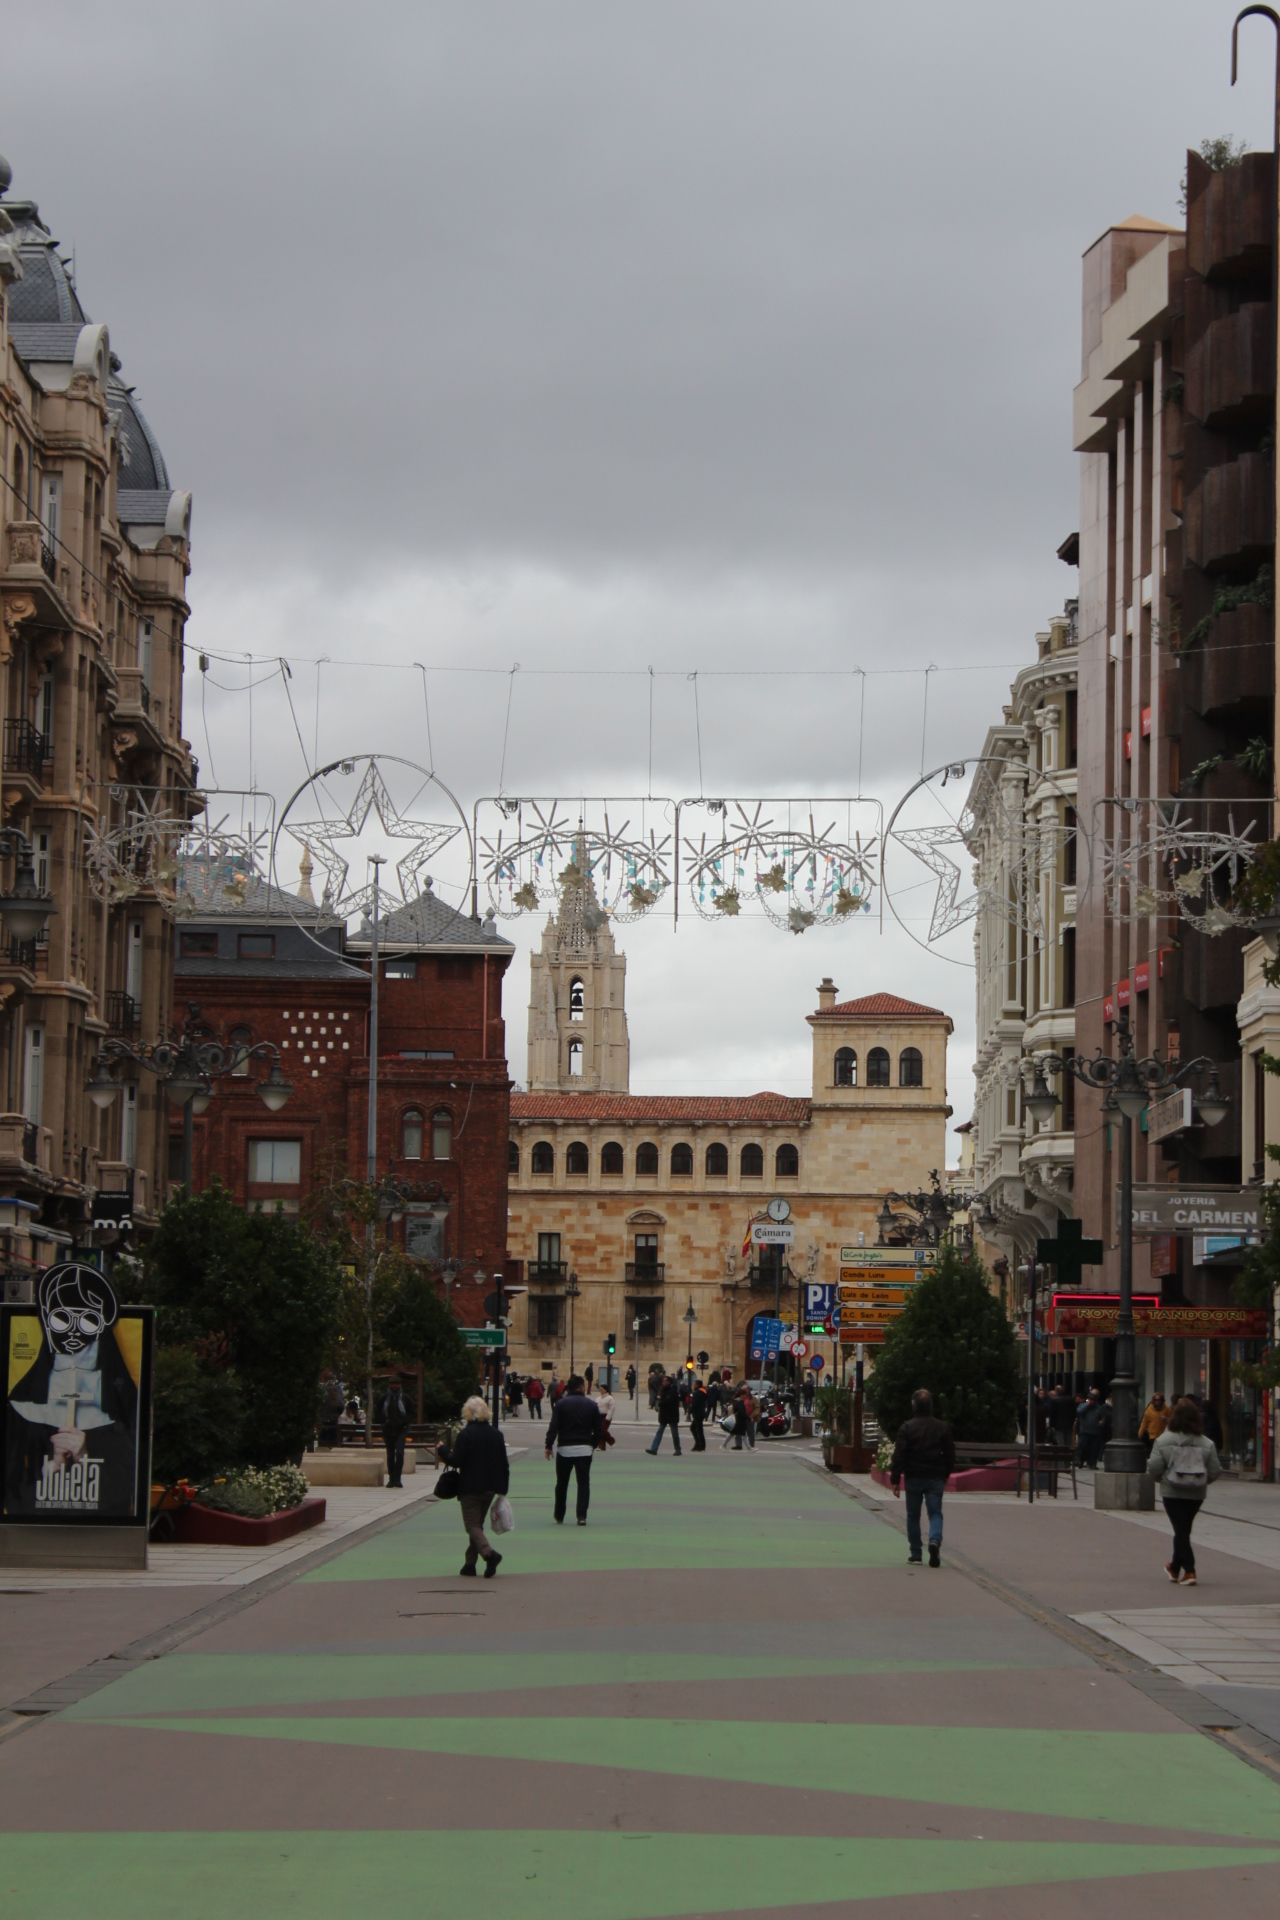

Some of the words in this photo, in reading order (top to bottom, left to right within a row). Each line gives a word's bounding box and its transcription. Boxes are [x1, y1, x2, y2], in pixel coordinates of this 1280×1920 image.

[1168, 1196, 1216, 1205] JOYERIA
[1173, 1209, 1257, 1225] CARMEN
[754, 1227, 791, 1239] Cámara
[868, 1271, 885, 1279] Luna
[808, 1285, 823, 1310] P
[1147, 1308, 1247, 1321] TANDOORI
[36, 1454, 104, 1502] Julieta
